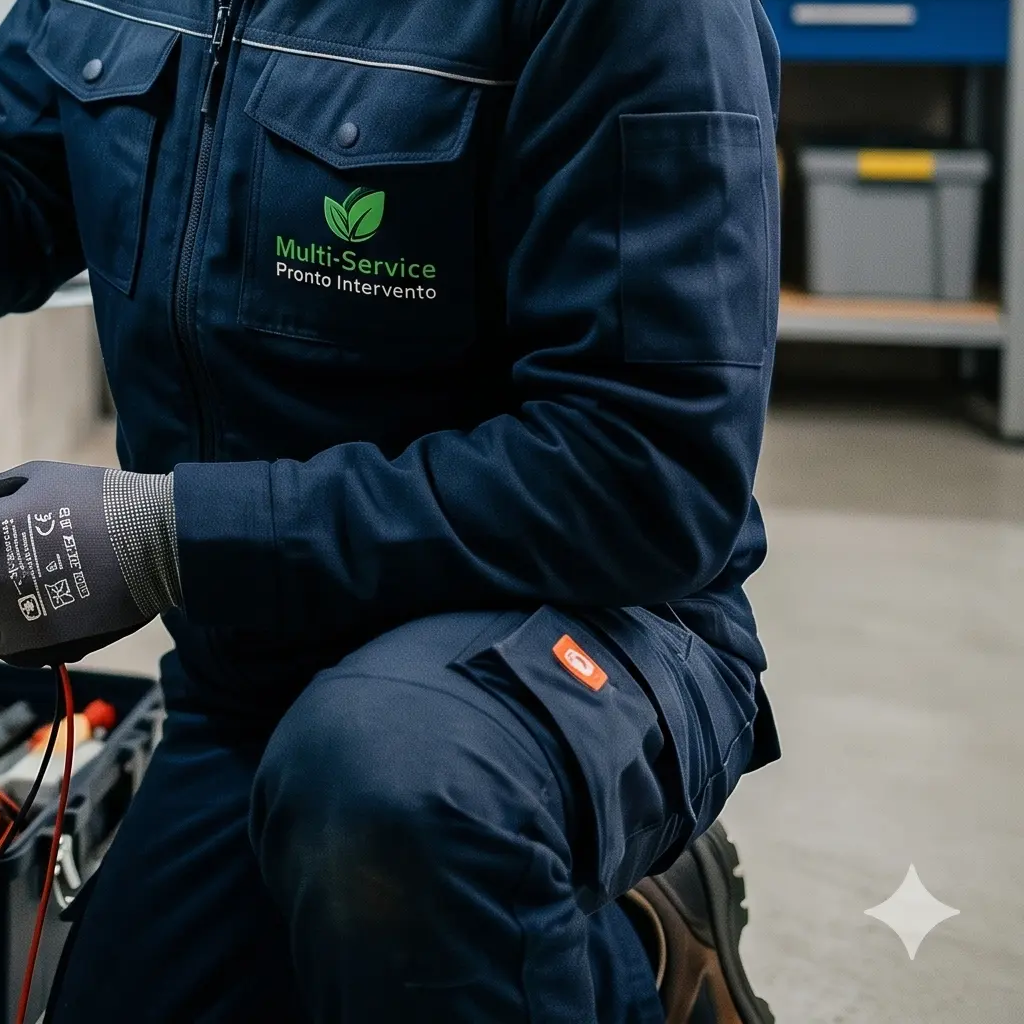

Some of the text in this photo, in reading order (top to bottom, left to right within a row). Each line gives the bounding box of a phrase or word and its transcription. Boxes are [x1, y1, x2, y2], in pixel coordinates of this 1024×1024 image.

[276, 235, 436, 279] Multi-Service
[276, 261, 437, 300] Pronto Intervento
